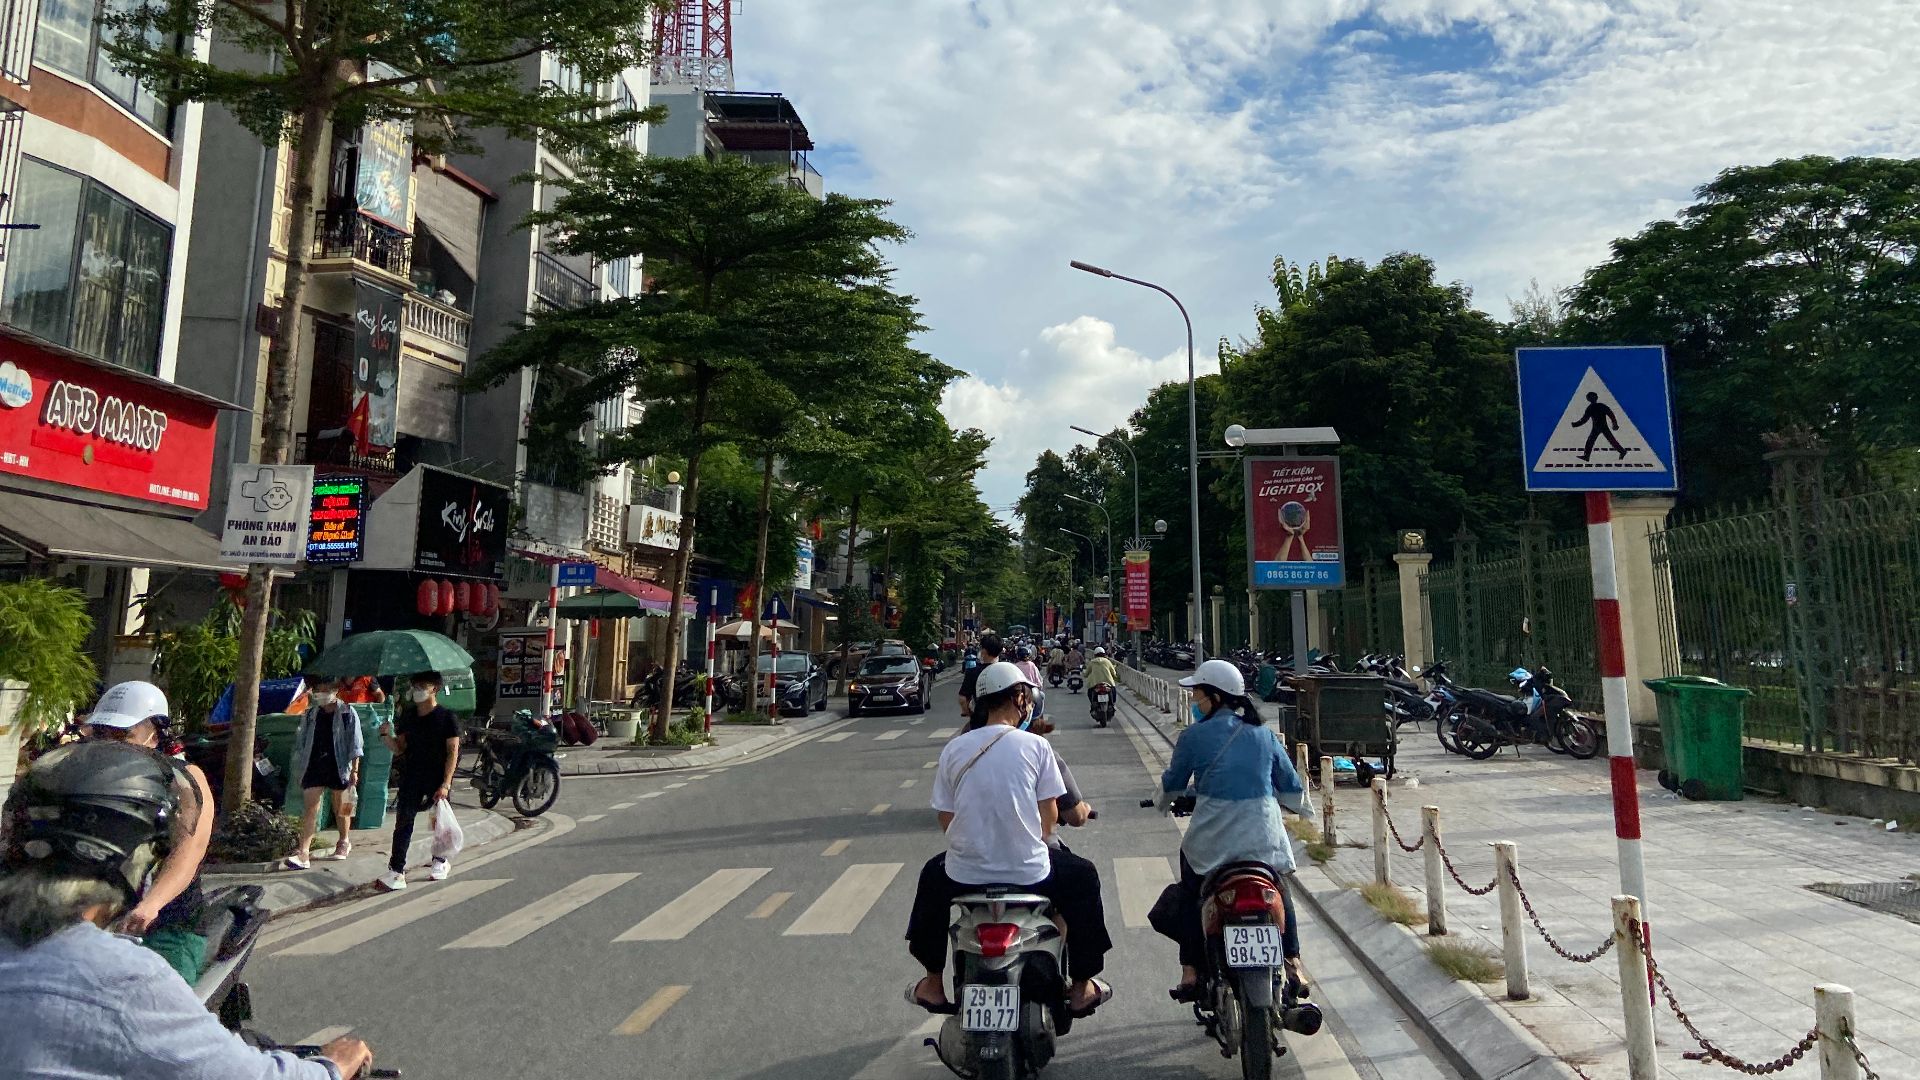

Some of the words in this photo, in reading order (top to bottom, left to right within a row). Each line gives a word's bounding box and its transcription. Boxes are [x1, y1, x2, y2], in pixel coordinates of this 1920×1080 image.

[47, 380, 99, 434] ATB
[99, 395, 168, 453] MART
[1291, 466, 1315, 477] KIỆM
[1258, 484, 1297, 497] LIGHT
[1296, 481, 1325, 494] BOX
[227, 518, 264, 531] PHÒNG
[266, 519, 297, 532] KHÁM
[242, 535, 258, 546] AN
[260, 532, 282, 546] BẢO
[1267, 570, 1290, 579] 0865
[1290, 570, 1303, 579] 86
[1304, 570, 1316, 579] 87
[1317, 570, 1329, 579] 86
[1232, 927, 1272, 945] 29-D1
[1229, 945, 1278, 964] 984.57
[966, 1008, 1015, 1029] 118.77
